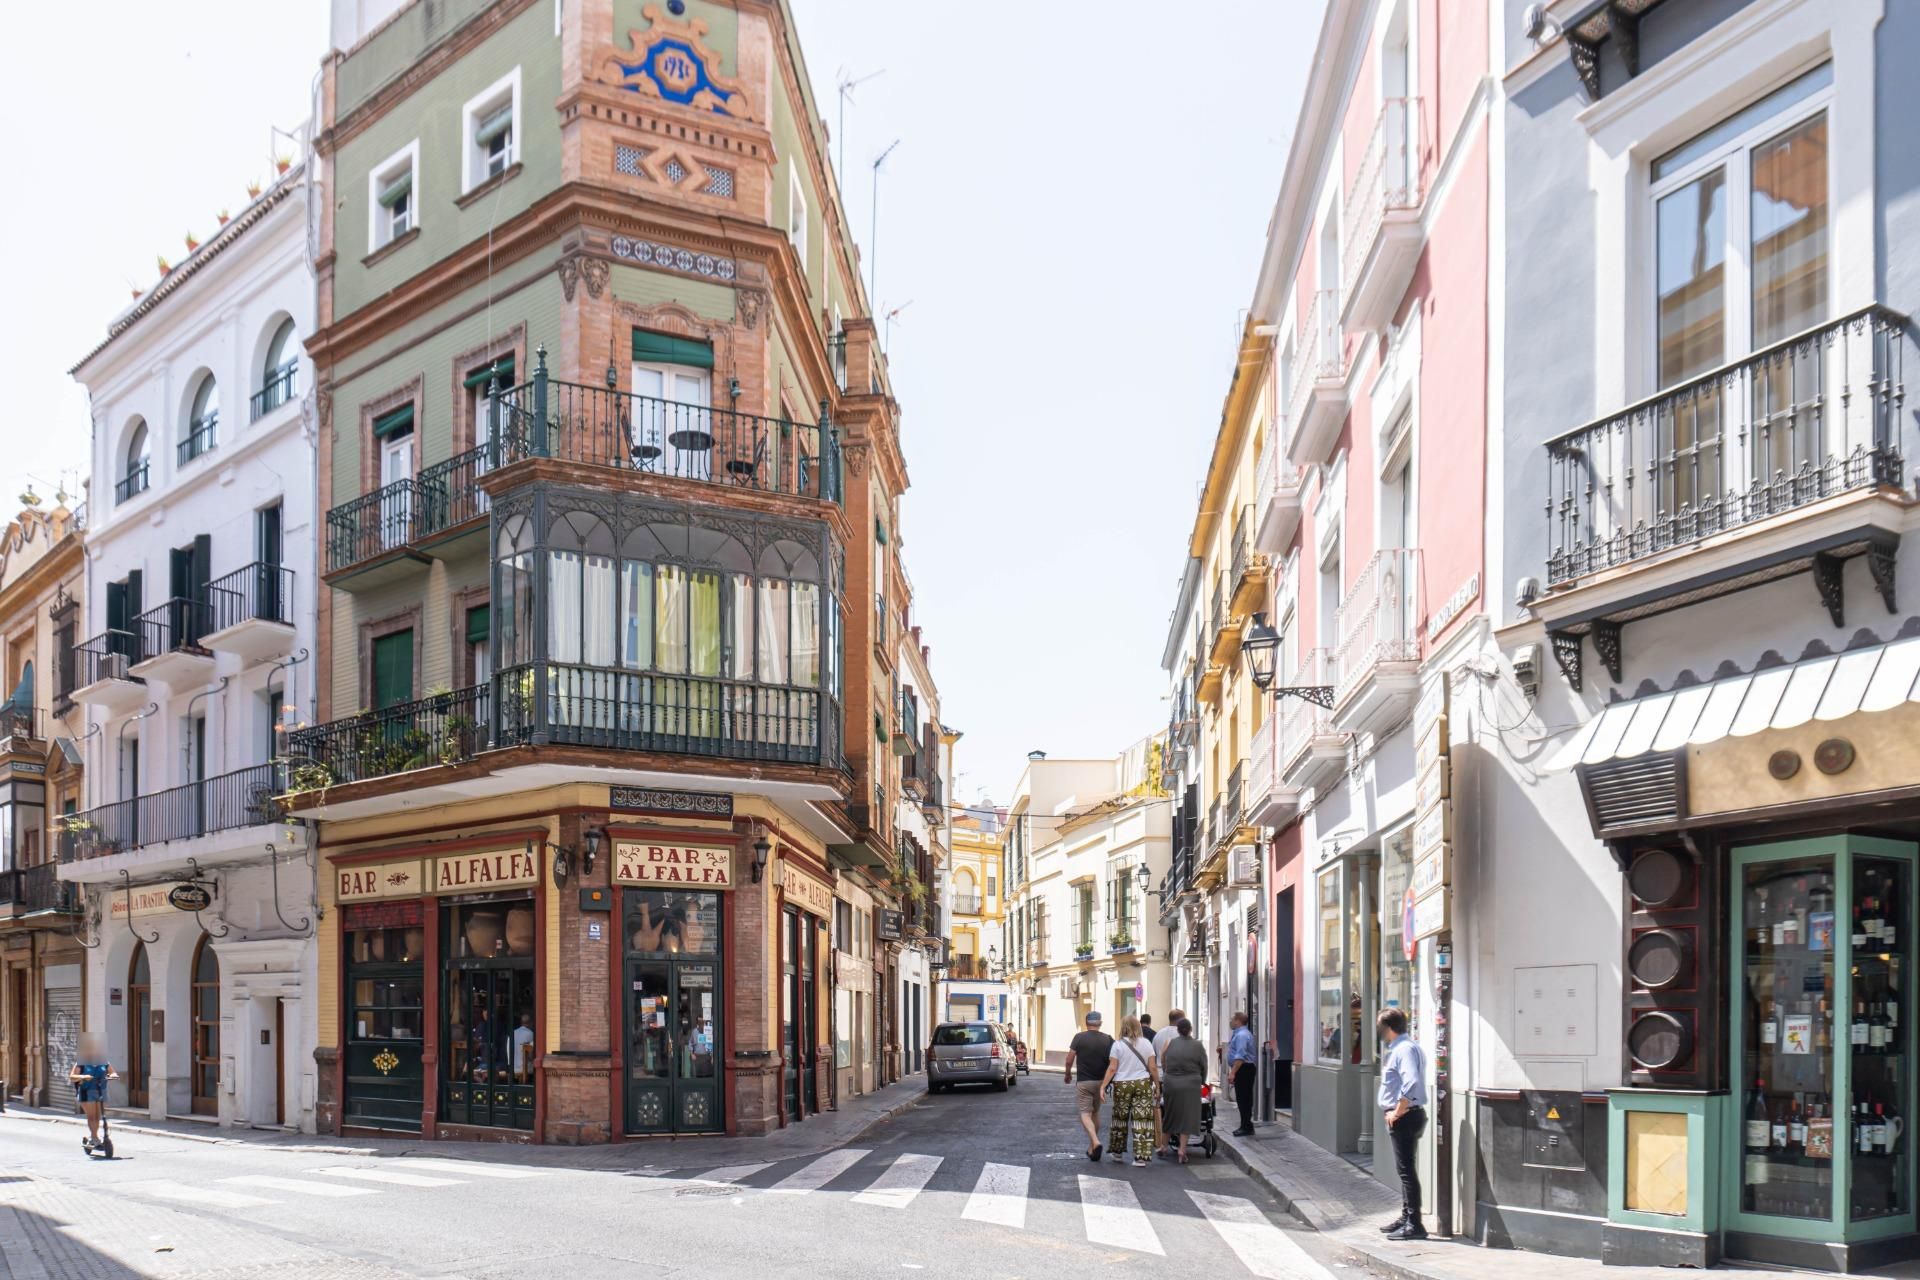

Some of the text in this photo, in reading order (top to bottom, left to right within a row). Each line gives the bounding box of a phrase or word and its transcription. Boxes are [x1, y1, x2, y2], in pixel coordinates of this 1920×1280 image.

[648, 846, 701, 864] BAR
[340, 871, 377, 895] BAR
[439, 853, 535, 887] ALFALFA
[618, 864, 728, 883] ALFALFA
